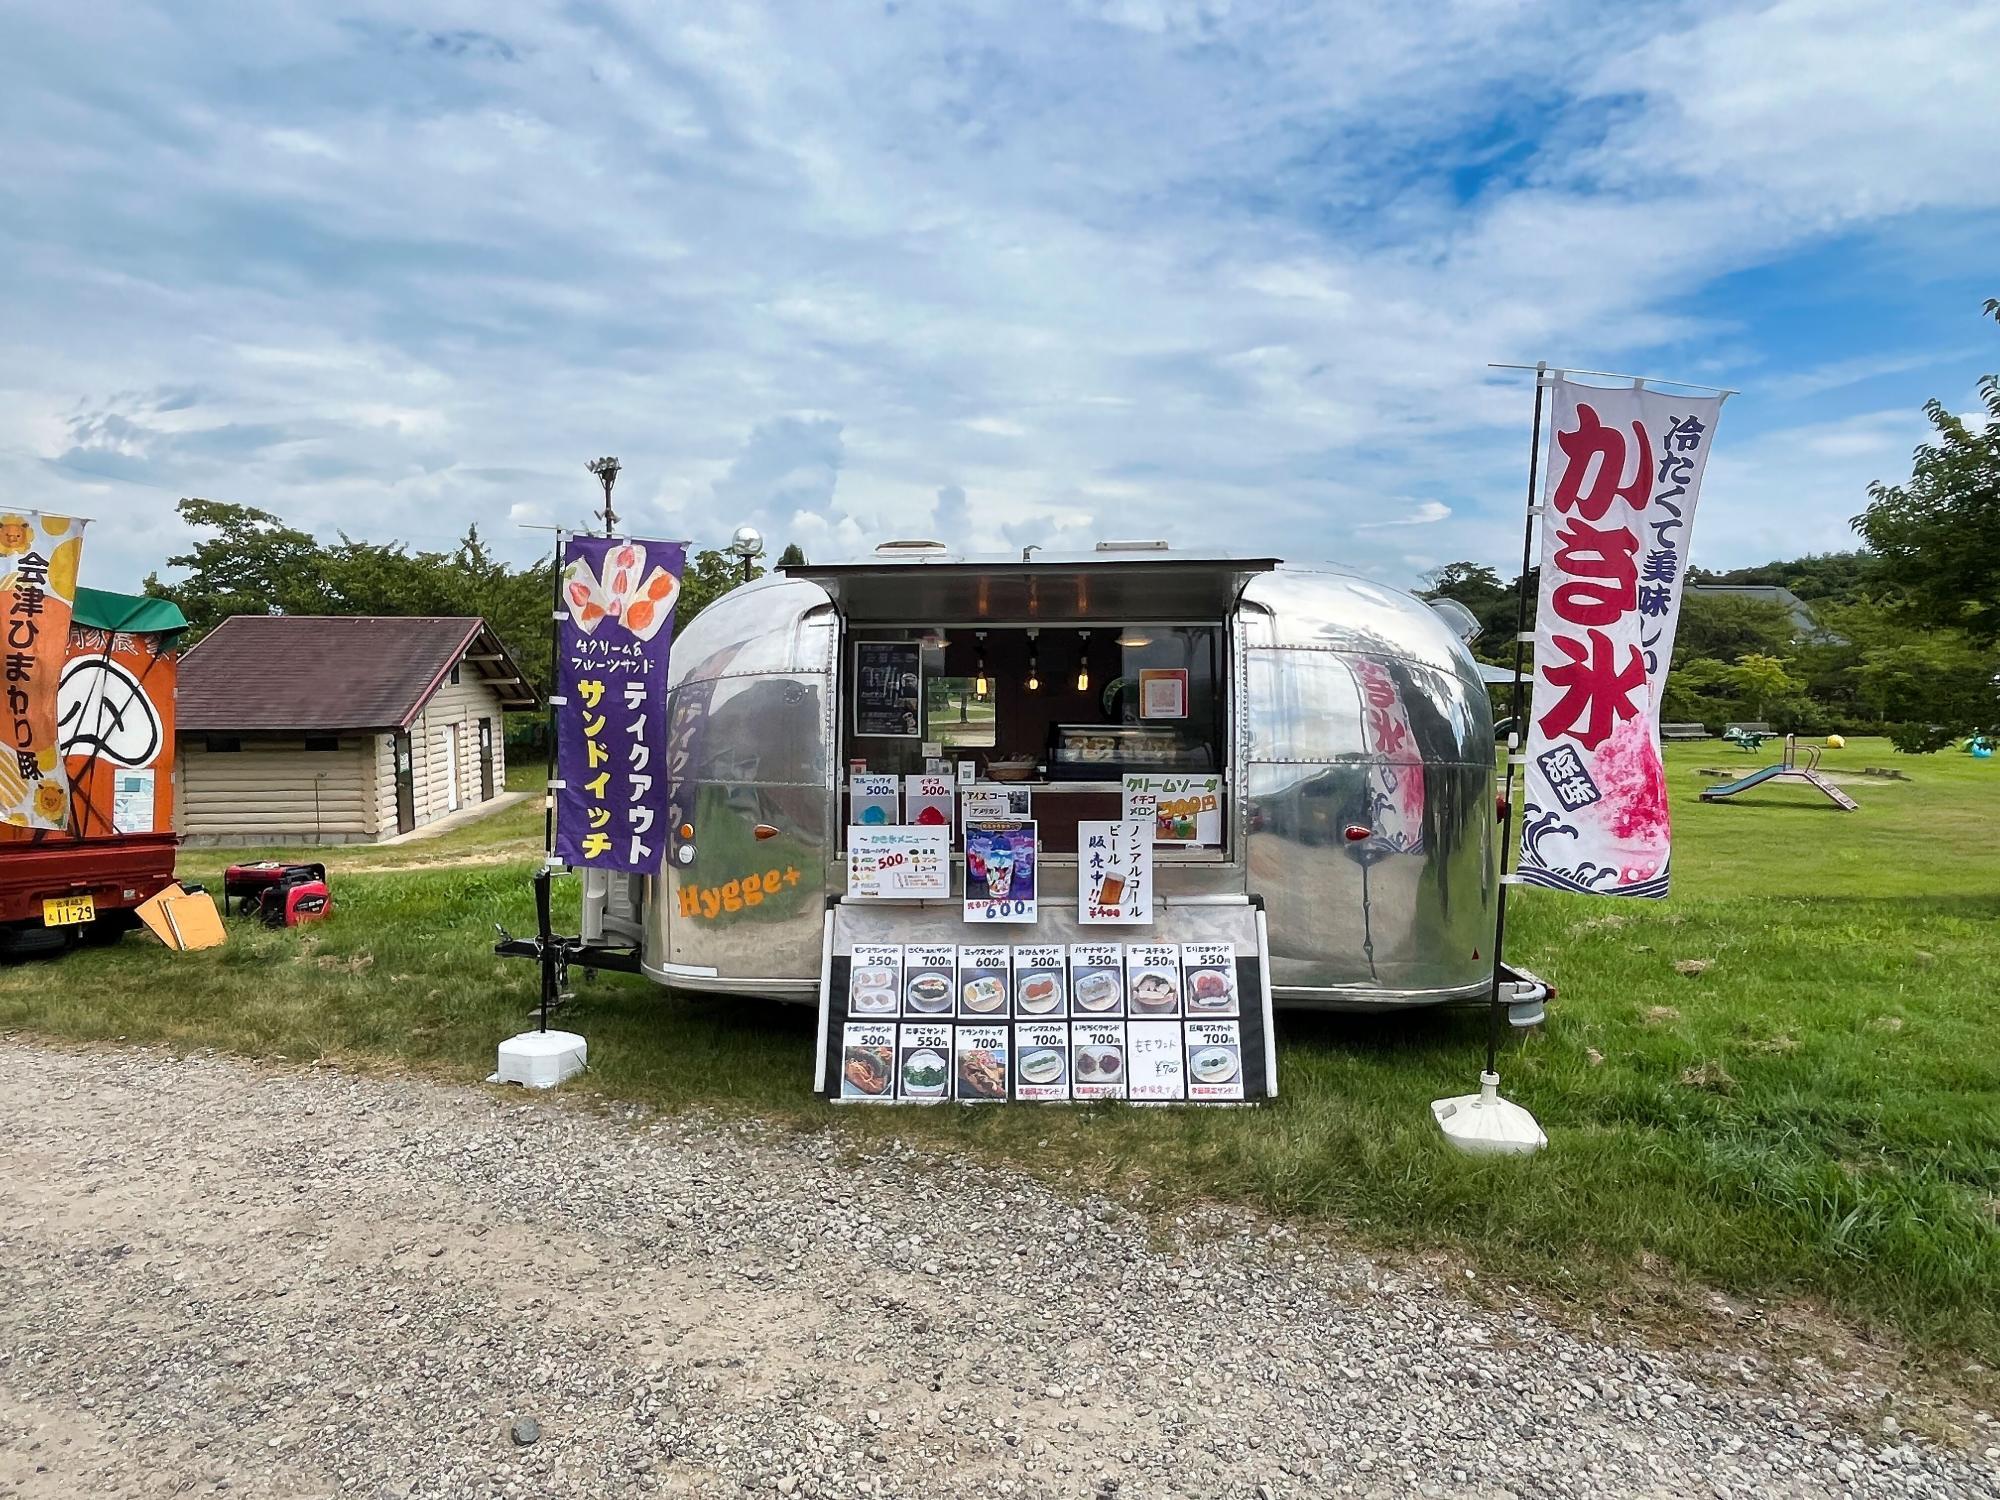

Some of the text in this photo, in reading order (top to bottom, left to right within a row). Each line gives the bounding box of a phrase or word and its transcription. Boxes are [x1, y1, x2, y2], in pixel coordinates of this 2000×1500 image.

[1538, 403, 1654, 751] かき氷
[6, 552, 49, 780] 会津ひまわり豚
[572, 657, 655, 674] フルーツサンド
[578, 679, 613, 860] サンドイッチ
[624, 682, 654, 865] テイクアウト
[866, 786, 894, 795] 500円
[922, 786, 950, 795] 500円
[1126, 778, 1218, 793] クリームソーダ
[1130, 795, 1156, 804] イチゴ
[1130, 807, 1155, 816] メロン
[1108, 824, 1122, 865] ビール
[1128, 825, 1143, 918] ノンアルコール
[58, 906, 93, 923] 11-29
[1018, 948, 1059, 956] みかんサンド
[1075, 946, 1117, 954] バナナサンド
[868, 956, 897, 966] 550円
[922, 956, 951, 966] 700円
[975, 957, 1005, 967] 600円
[1031, 957, 1061, 967] 500円
[1088, 955, 1118, 966] 550円
[1144, 956, 1174, 966] 550円
[1200, 954, 1231, 965] 550円
[861, 1035, 891, 1045] 500円
[917, 1036, 948, 1047] 550円
[972, 1038, 1003, 1049] 700円
[1033, 1034, 1063, 1045] 700円
[1089, 1033, 1121, 1044] 700円
[1203, 1033, 1235, 1044] 700円
